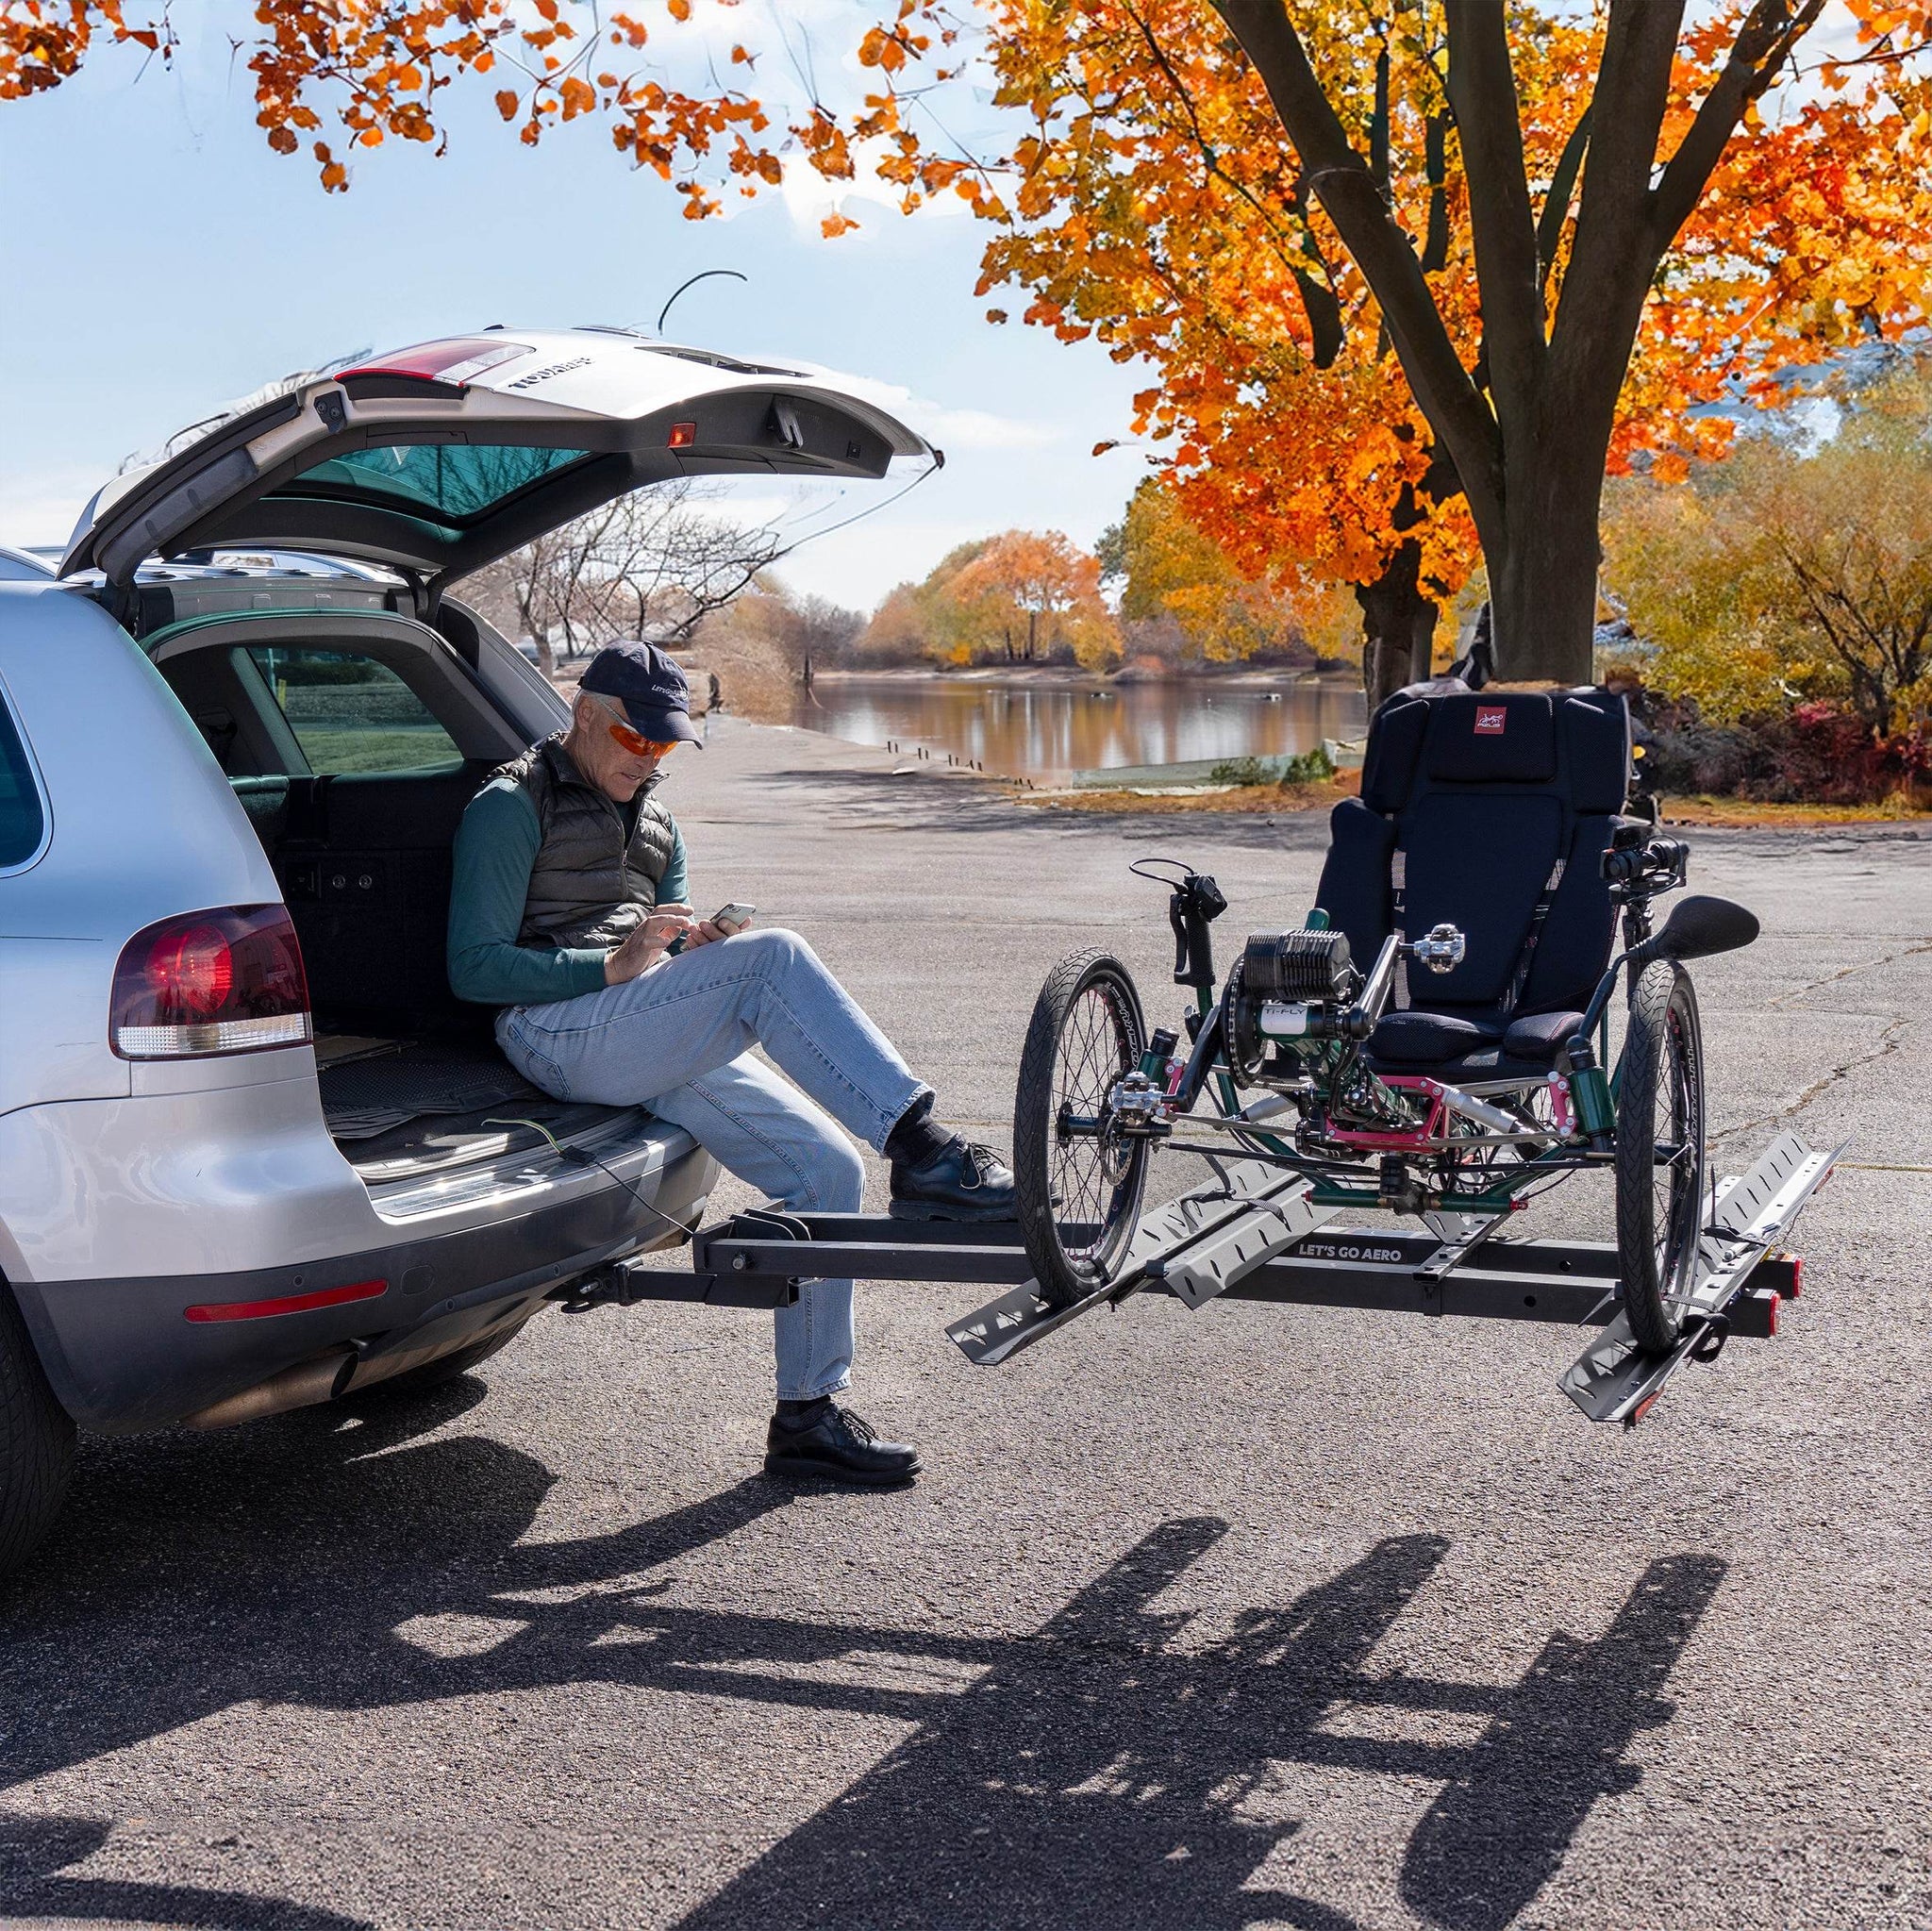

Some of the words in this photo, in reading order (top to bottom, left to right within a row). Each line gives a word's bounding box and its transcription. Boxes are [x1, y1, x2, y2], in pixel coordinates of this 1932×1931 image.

[1298, 1243, 1336, 1257] LET'S
[1338, 1246, 1360, 1259] GO
[1361, 1248, 1402, 1262] AERO
